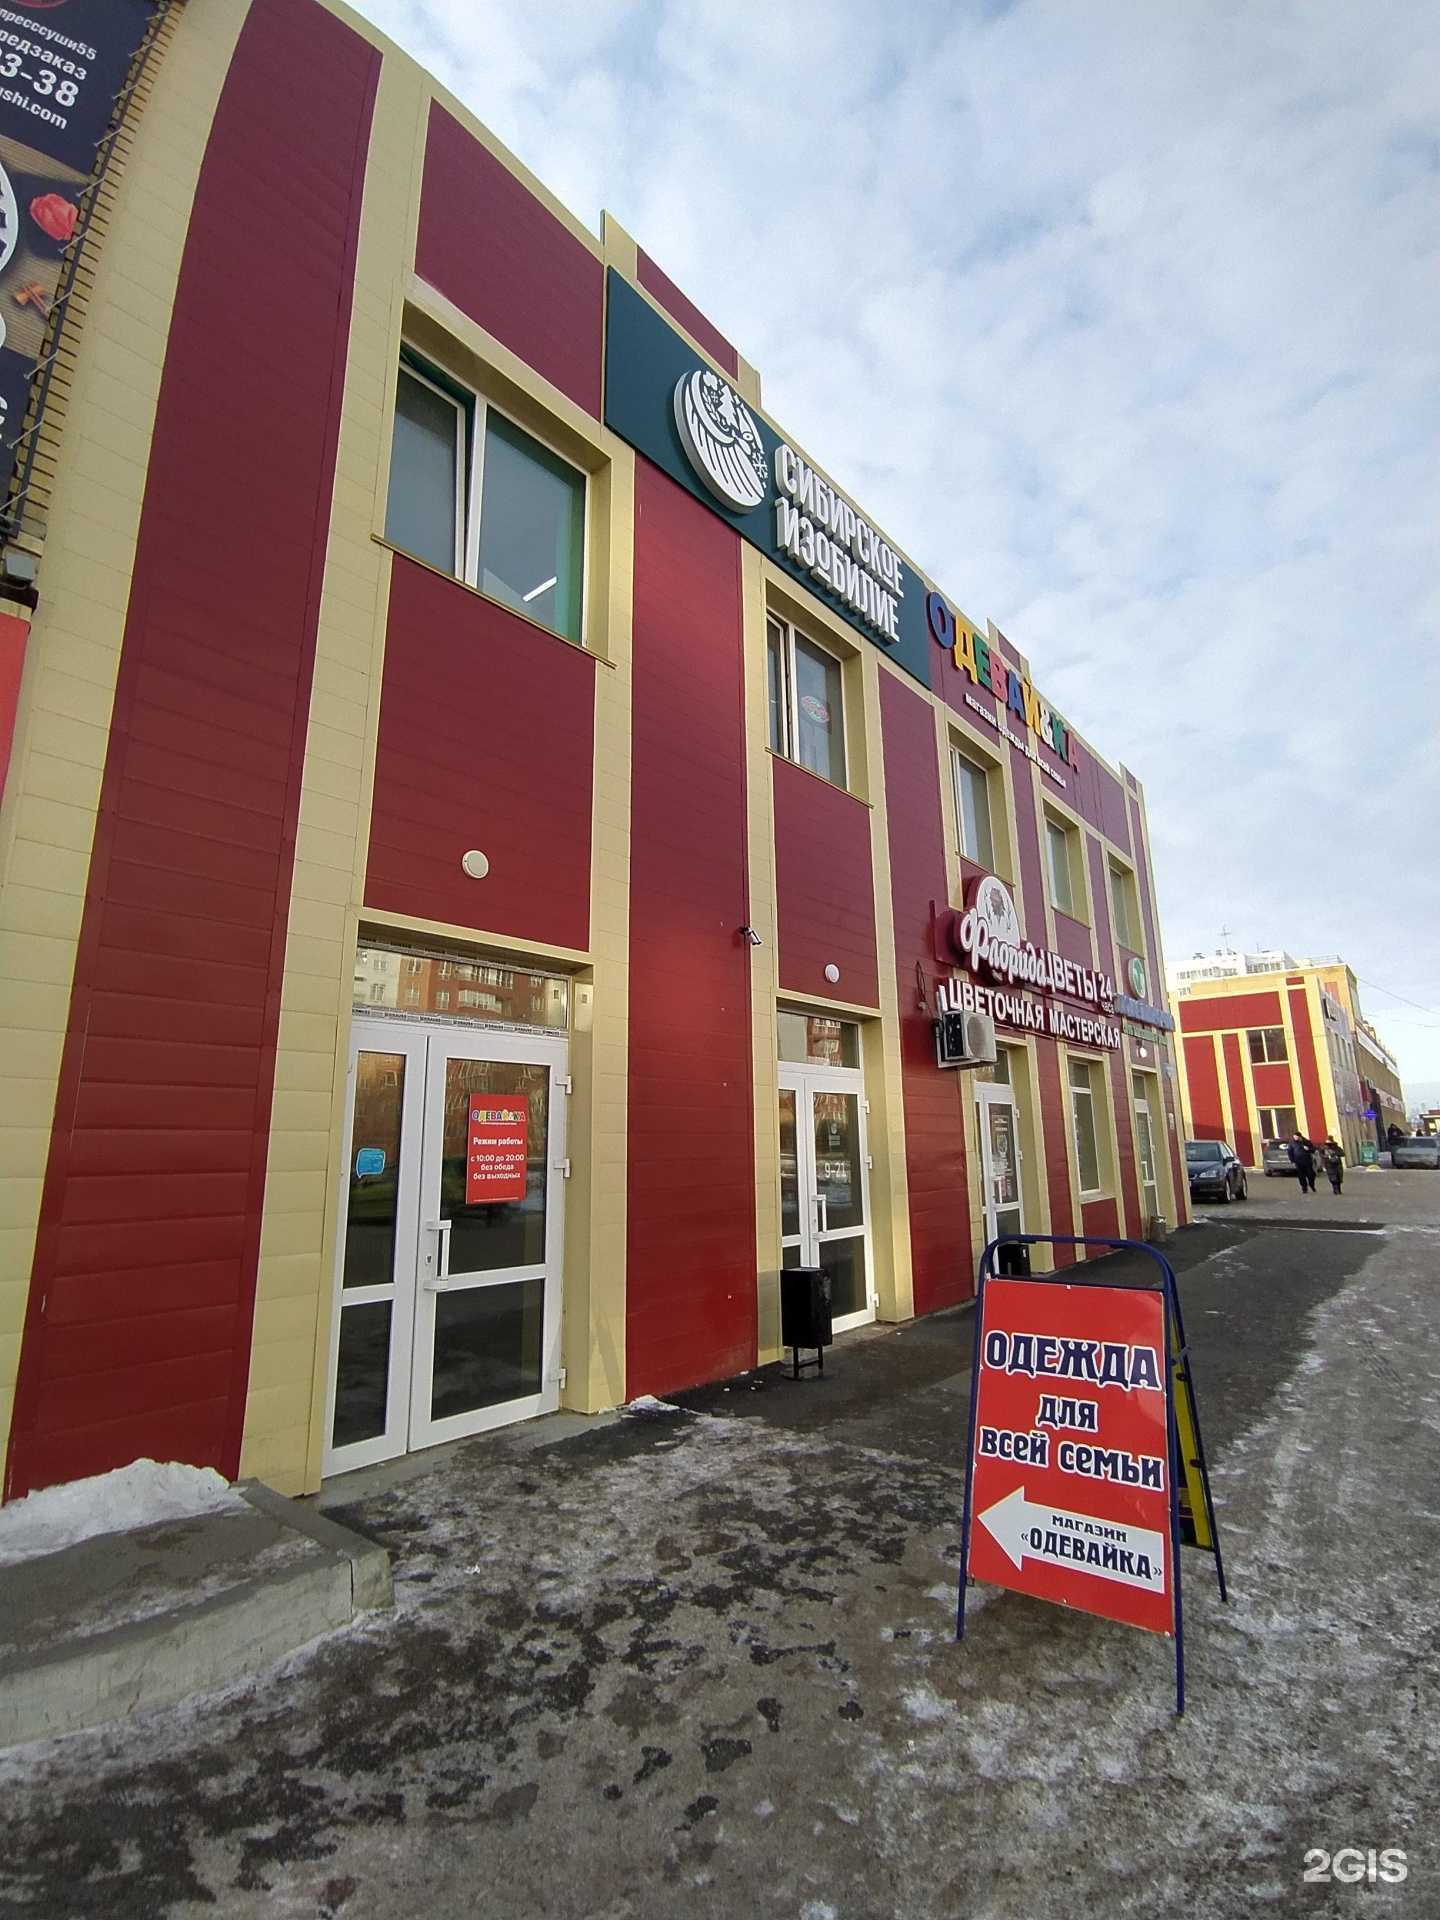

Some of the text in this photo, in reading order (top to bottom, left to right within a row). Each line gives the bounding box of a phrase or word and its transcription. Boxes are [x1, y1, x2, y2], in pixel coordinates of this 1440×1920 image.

[0, 48, 79, 107] 3-38
[775, 443, 904, 599] СИБИРСКОЕ
[774, 497, 901, 643] ИЗОБИЛИЕ
[1098, 972, 1113, 1002] 24
[949, 977, 1045, 1031] ЦВЕТОЧНАЯ
[1049, 1008, 1121, 1048] МАСТЕРСКАЯ
[473, 1136, 523, 1147] Режим работы
[476, 1154, 495, 1162] 10:00
[473, 1172, 520, 1180] без выходных
[494, 1163, 514, 1171] обеда
[825, 1162, 847, 1178] 9-21
[986, 1331, 1161, 1390] ОДЕЖДА
[1021, 1527, 1162, 1581] «ОДЕВАЙКА»
